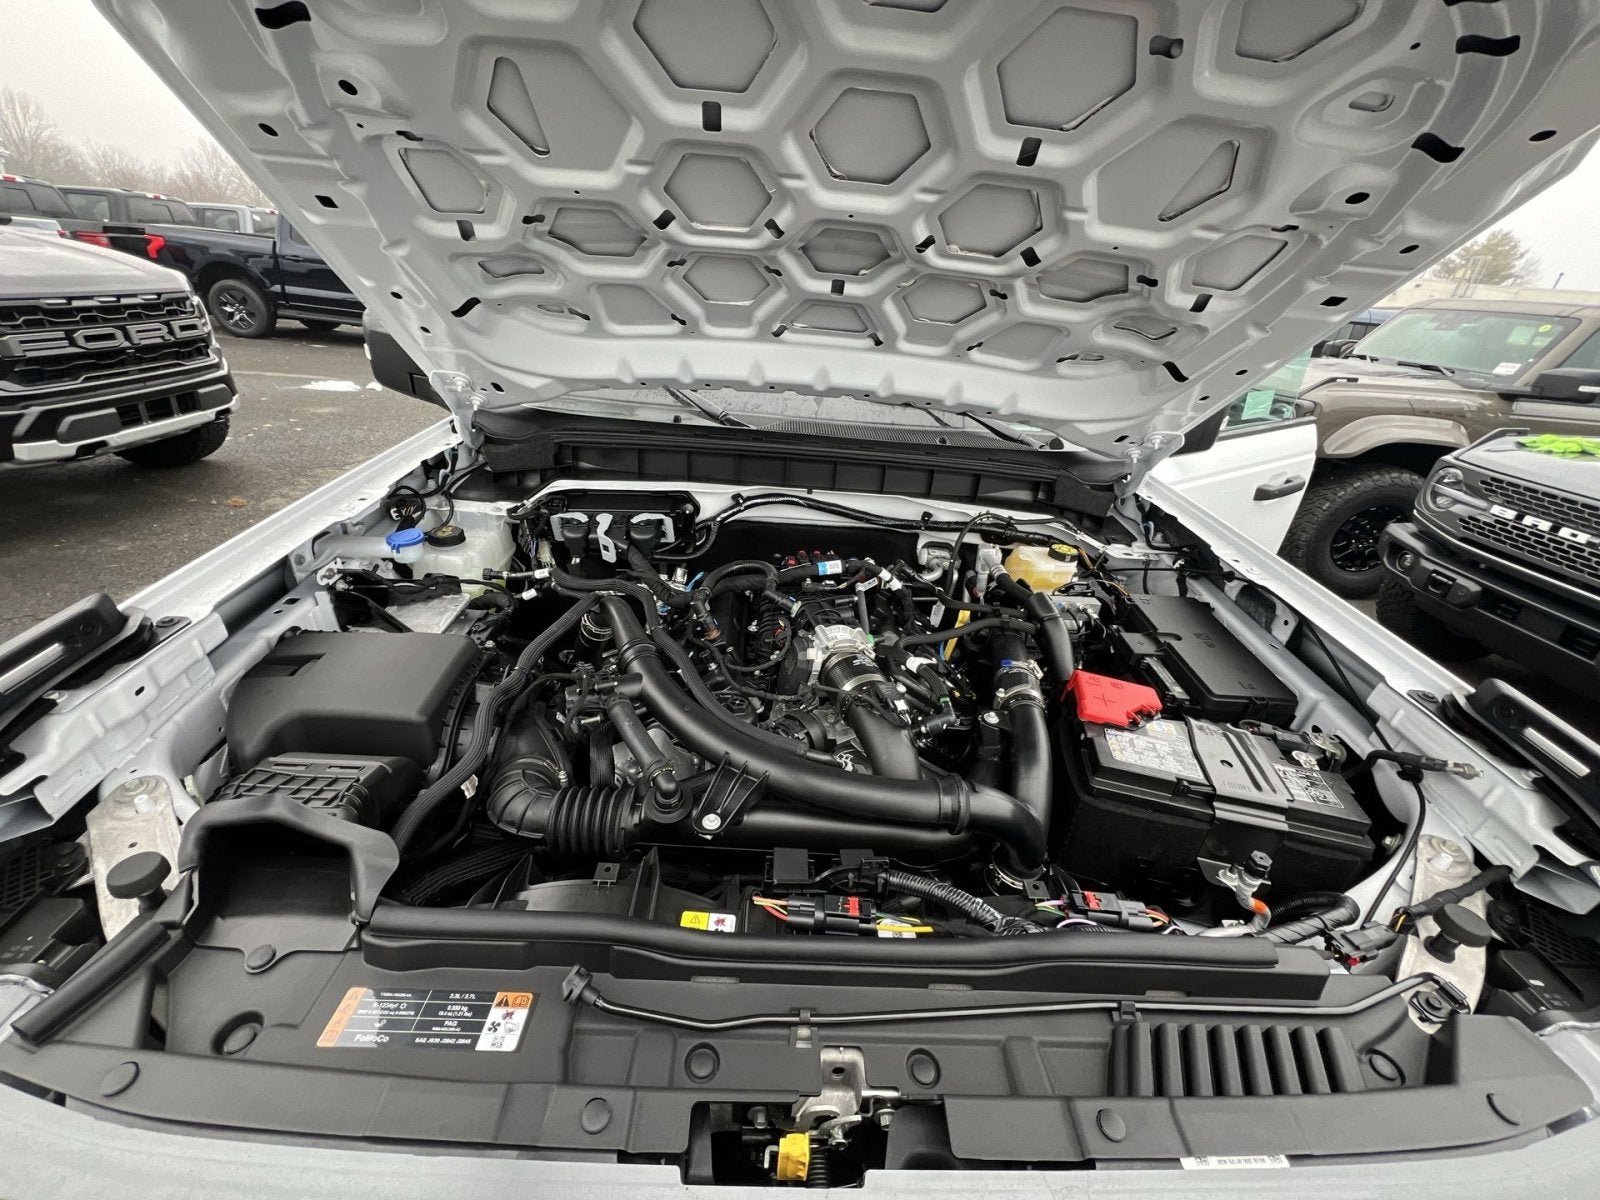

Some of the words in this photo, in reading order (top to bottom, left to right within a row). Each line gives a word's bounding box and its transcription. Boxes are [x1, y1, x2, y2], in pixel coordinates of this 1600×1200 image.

[0, 318, 206, 359] FORD
[1489, 504, 1600, 551] BRO
[354, 1033, 389, 1042] FoMoCo
